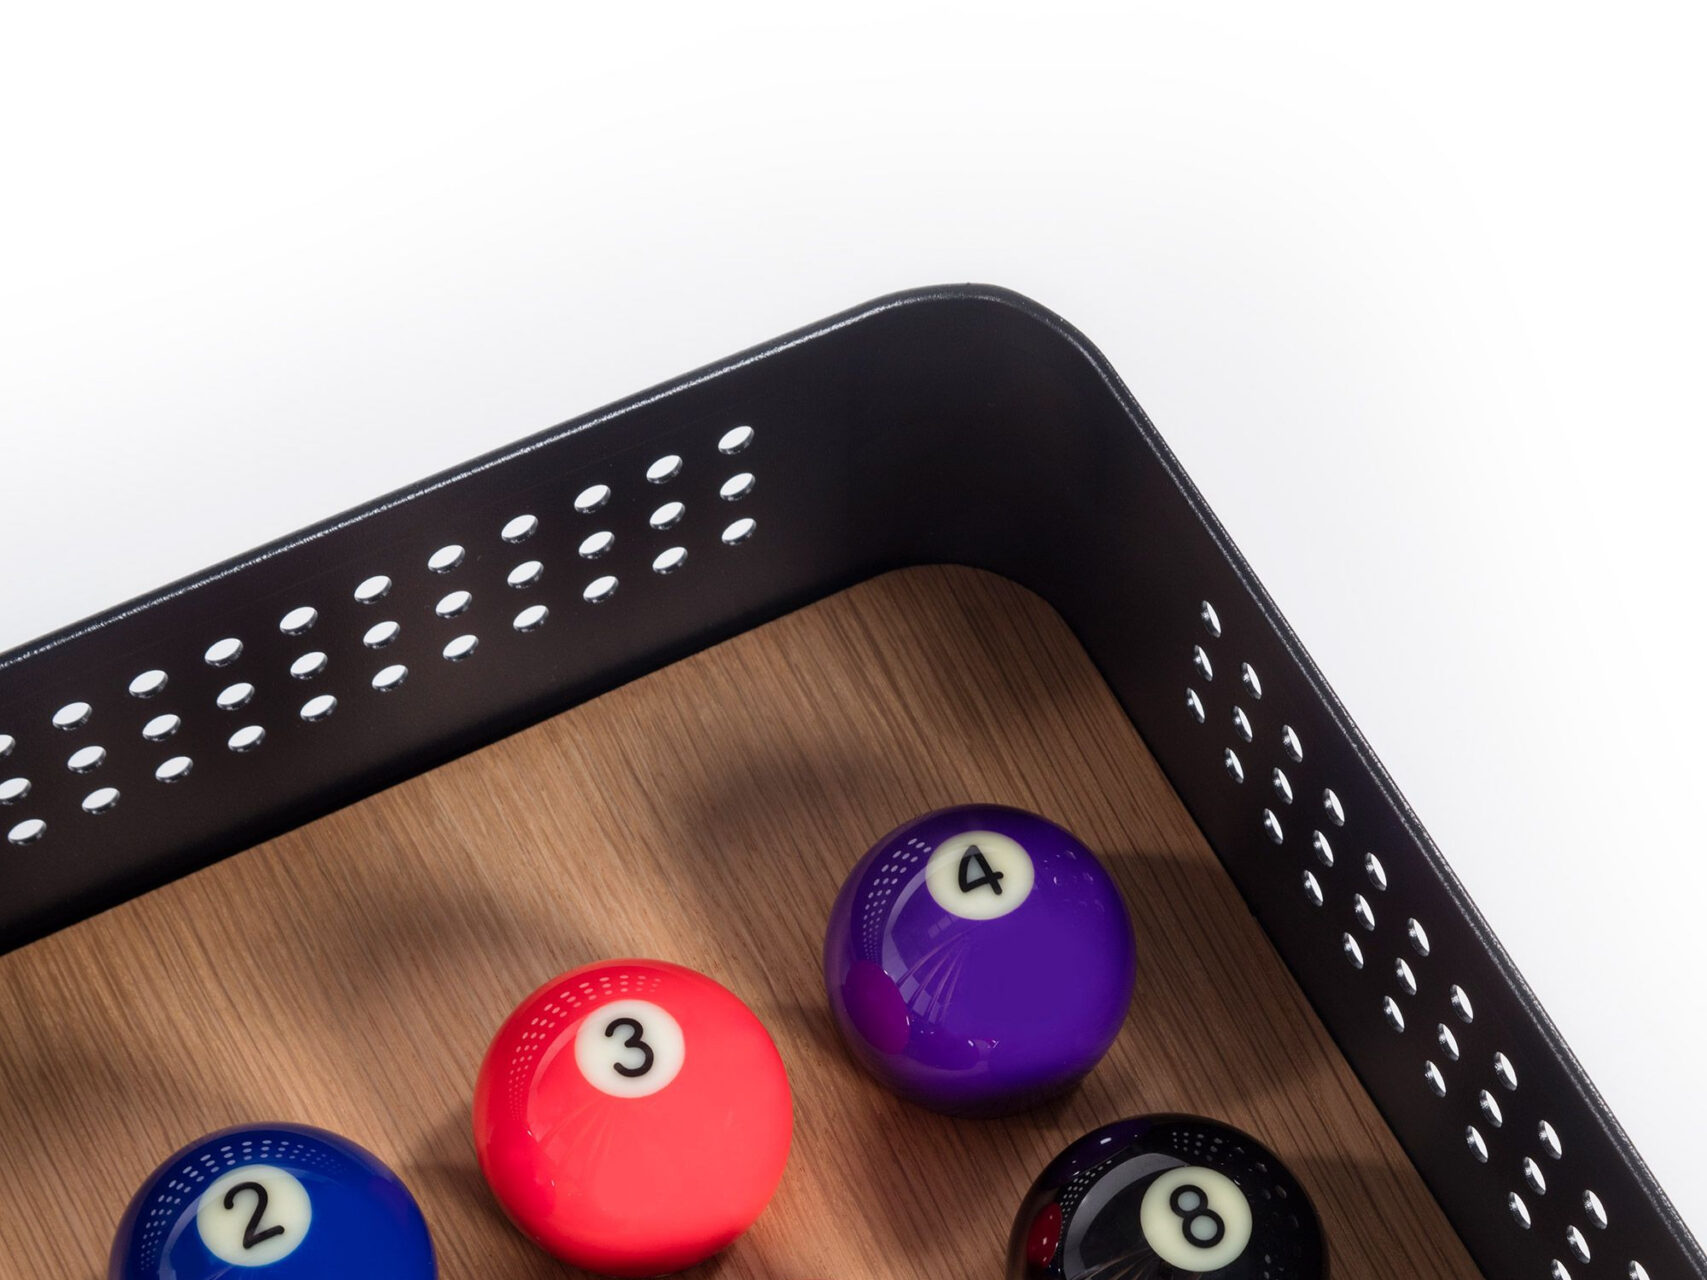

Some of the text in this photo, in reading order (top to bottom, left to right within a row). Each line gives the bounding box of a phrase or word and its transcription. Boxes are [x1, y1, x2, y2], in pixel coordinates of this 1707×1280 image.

[958, 842, 1004, 895] 4
[605, 1018, 654, 1078] 3
[223, 1182, 285, 1250] 2
[1169, 1184, 1225, 1249] 8
